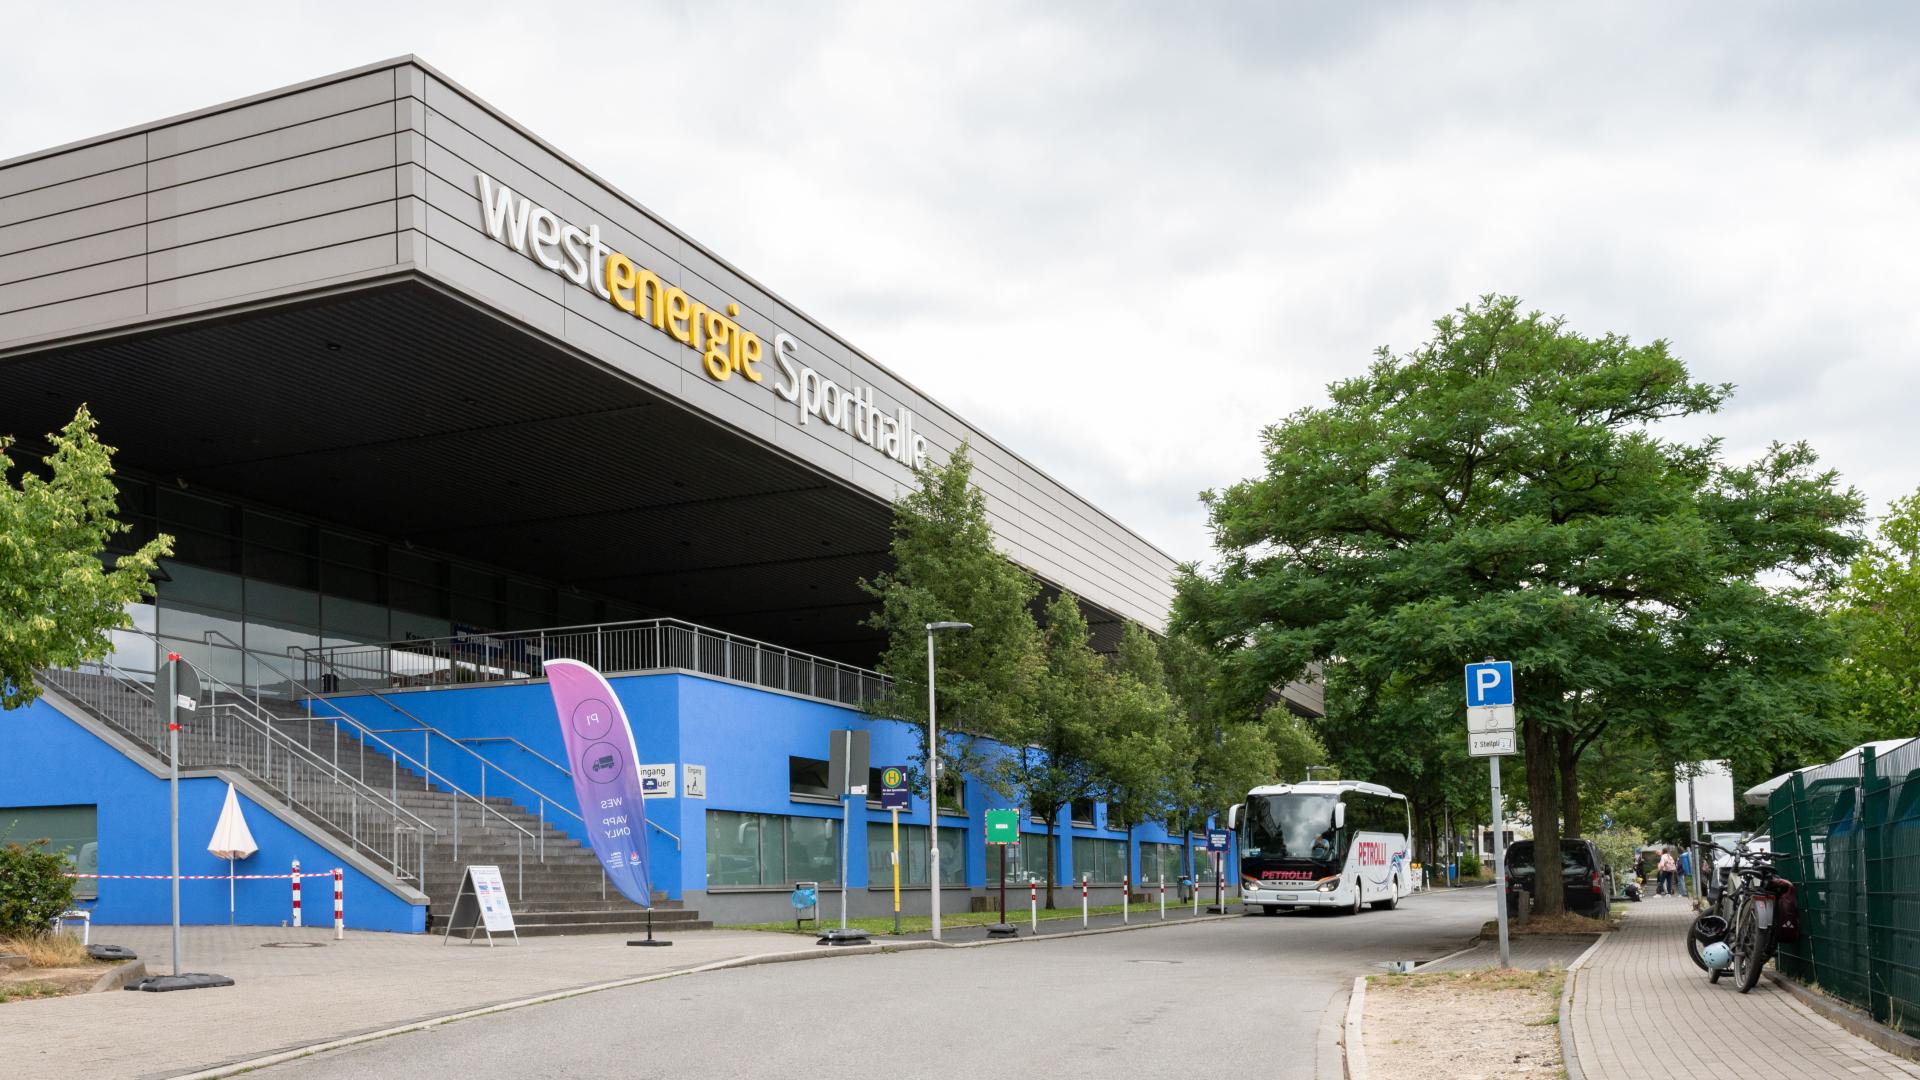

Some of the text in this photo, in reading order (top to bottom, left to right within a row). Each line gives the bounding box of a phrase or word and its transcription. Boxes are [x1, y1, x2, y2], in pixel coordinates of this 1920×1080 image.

[775, 333, 927, 470] Sporthalle
[1477, 669, 1501, 701] P
[641, 768, 666, 777] ingang
[902, 772, 907, 782] 1
[1358, 842, 1386, 866] PETROLLI
[1261, 870, 1313, 880] PETROLLI
